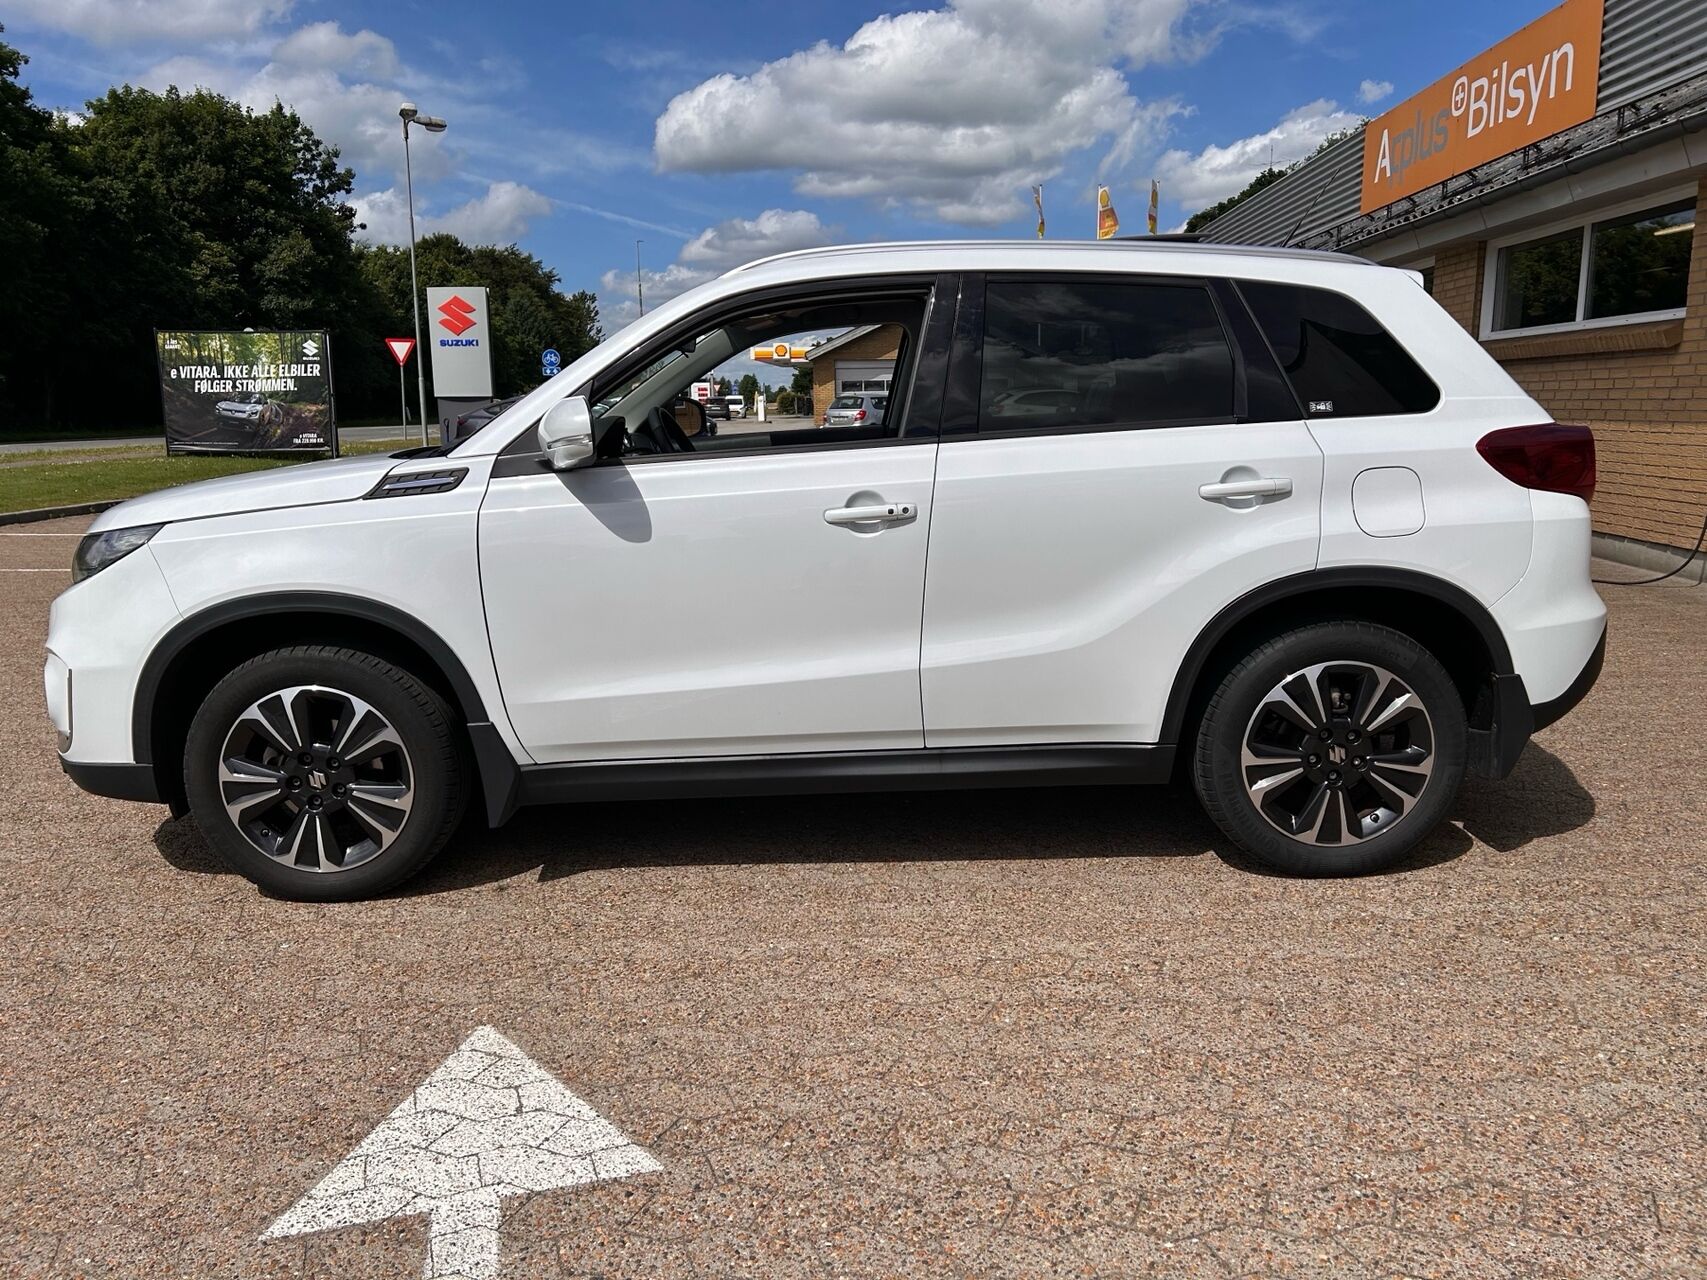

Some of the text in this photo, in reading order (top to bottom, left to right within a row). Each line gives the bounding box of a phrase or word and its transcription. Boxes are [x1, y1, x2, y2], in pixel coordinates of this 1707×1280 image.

[1467, 42, 1575, 139] Bilsyn
[439, 339, 479, 347] SUZUKI
[170, 363, 321, 379] e VITARA. IKKE ALLE ELBILER
[194, 378, 298, 394] FØLGER STRØMMEN.
